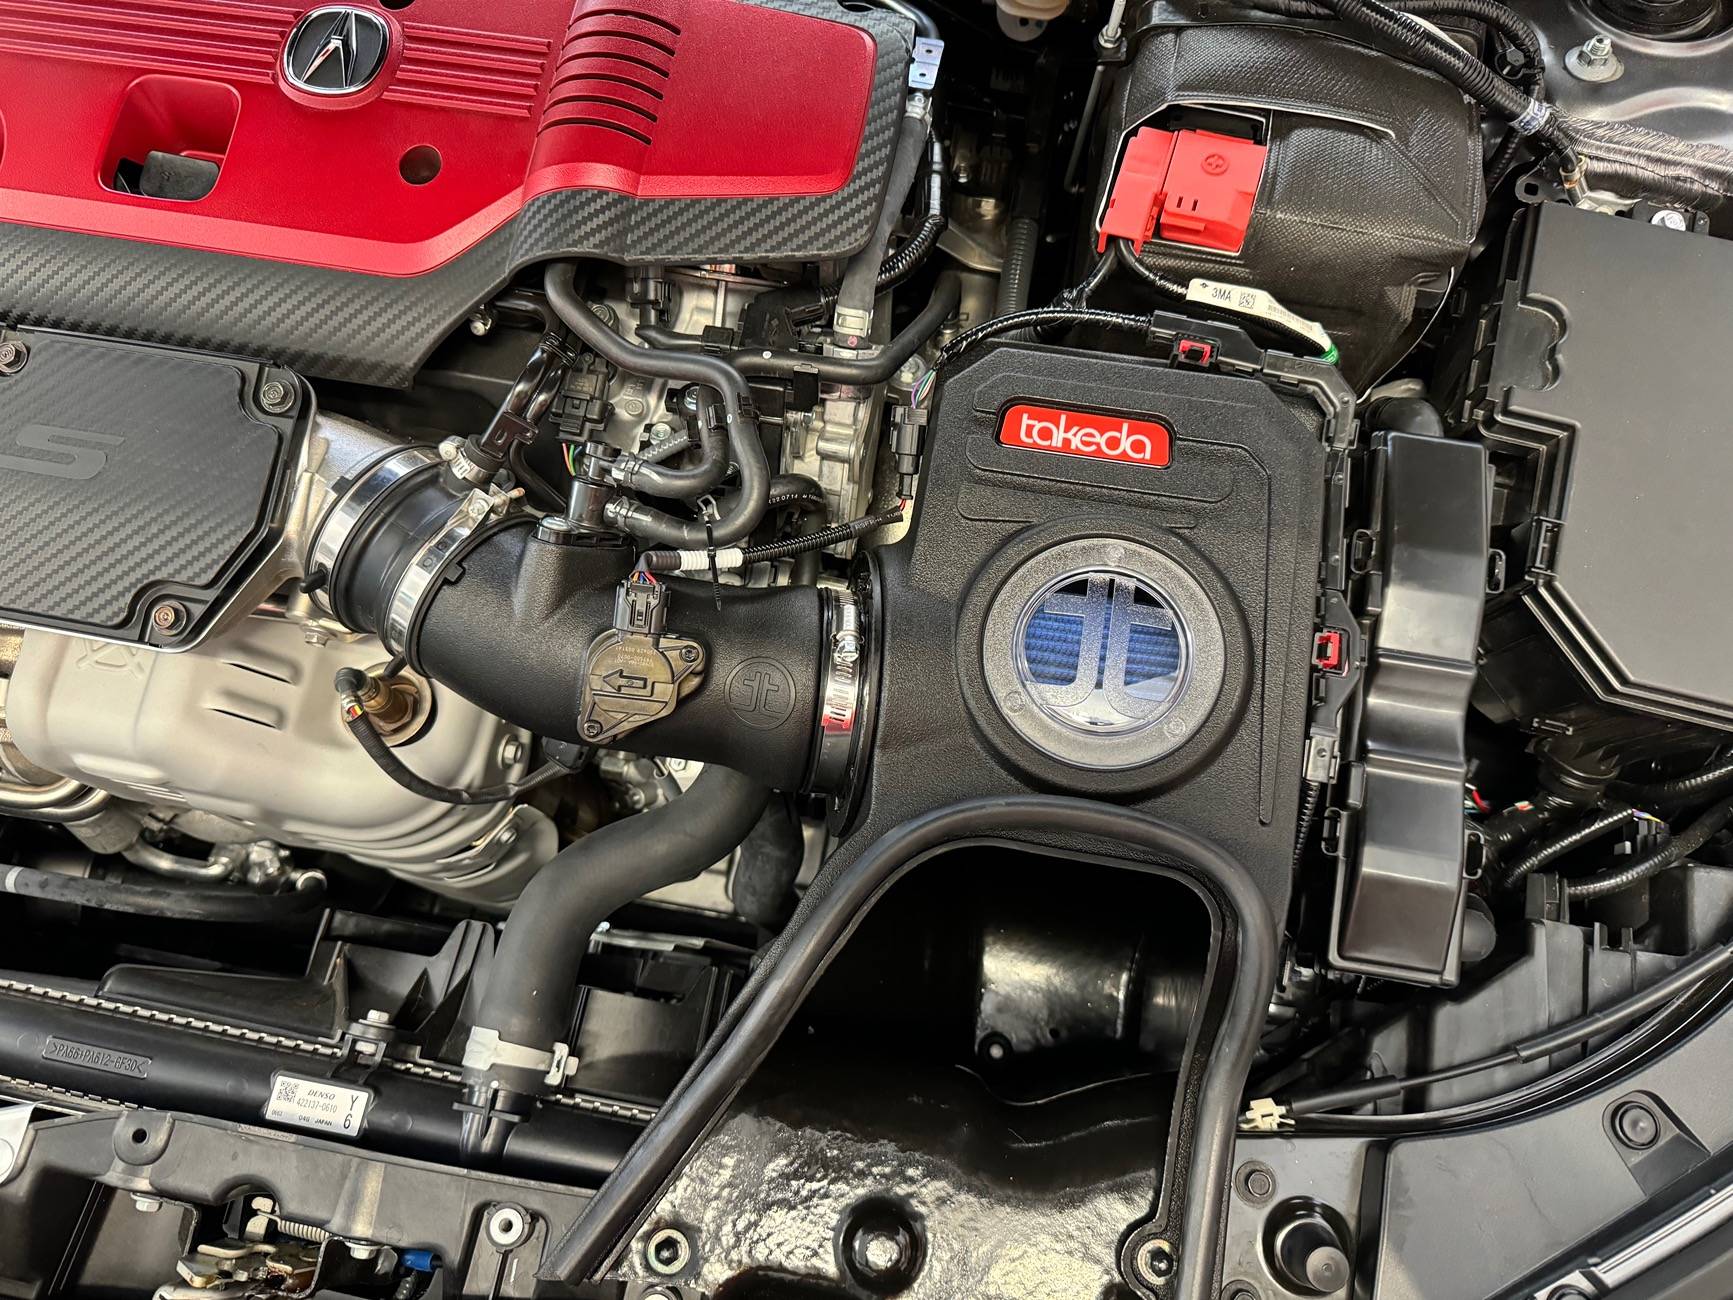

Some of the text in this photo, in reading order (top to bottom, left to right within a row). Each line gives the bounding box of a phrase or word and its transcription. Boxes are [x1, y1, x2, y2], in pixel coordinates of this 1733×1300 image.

[1211, 287, 1232, 303] 3MA
[1019, 413, 1152, 460] takeda
[307, 1089, 336, 1101] DENSO
[349, 1094, 359, 1111] Y
[296, 1097, 338, 1114] 422137-0610
[314, 1118, 333, 1126] JAPAN
[343, 1113, 353, 1129] 6
